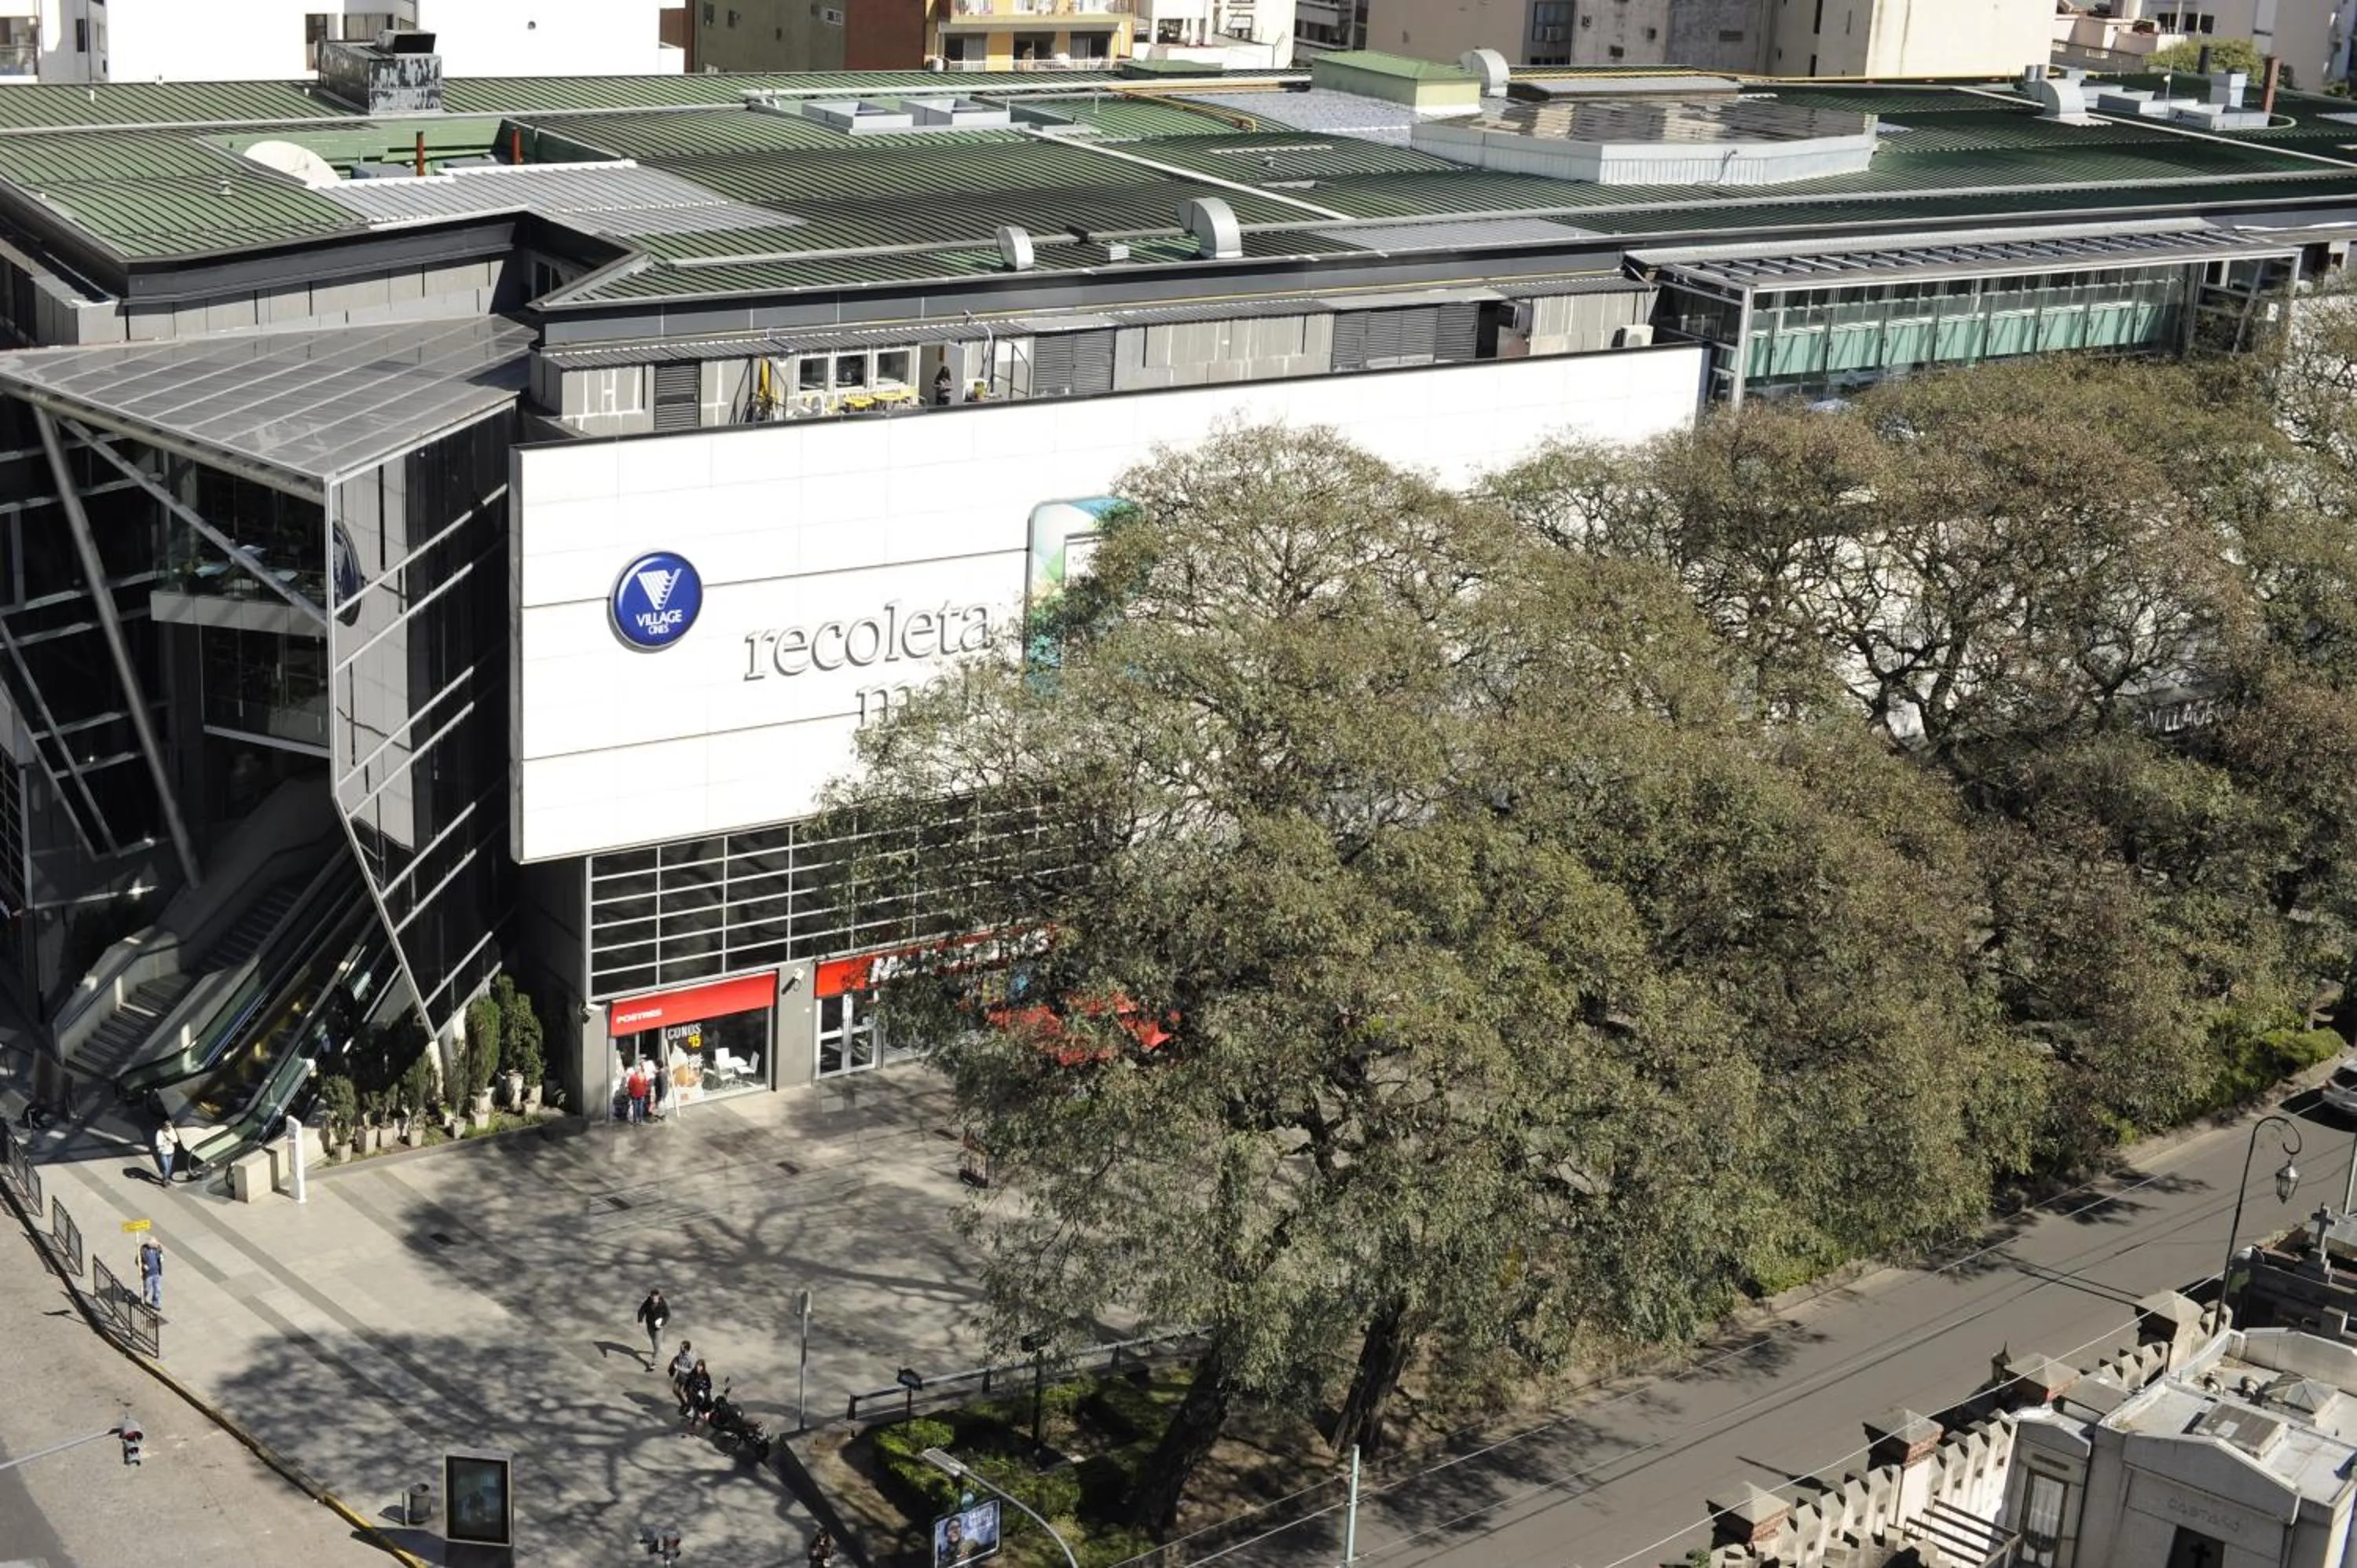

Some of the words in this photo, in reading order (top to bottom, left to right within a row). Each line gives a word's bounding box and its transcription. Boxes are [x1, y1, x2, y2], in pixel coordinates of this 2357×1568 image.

[636, 609, 683, 627] VILLAGE
[743, 599, 995, 682] recoleta
[2146, 699, 2215, 735] VLLAGE
